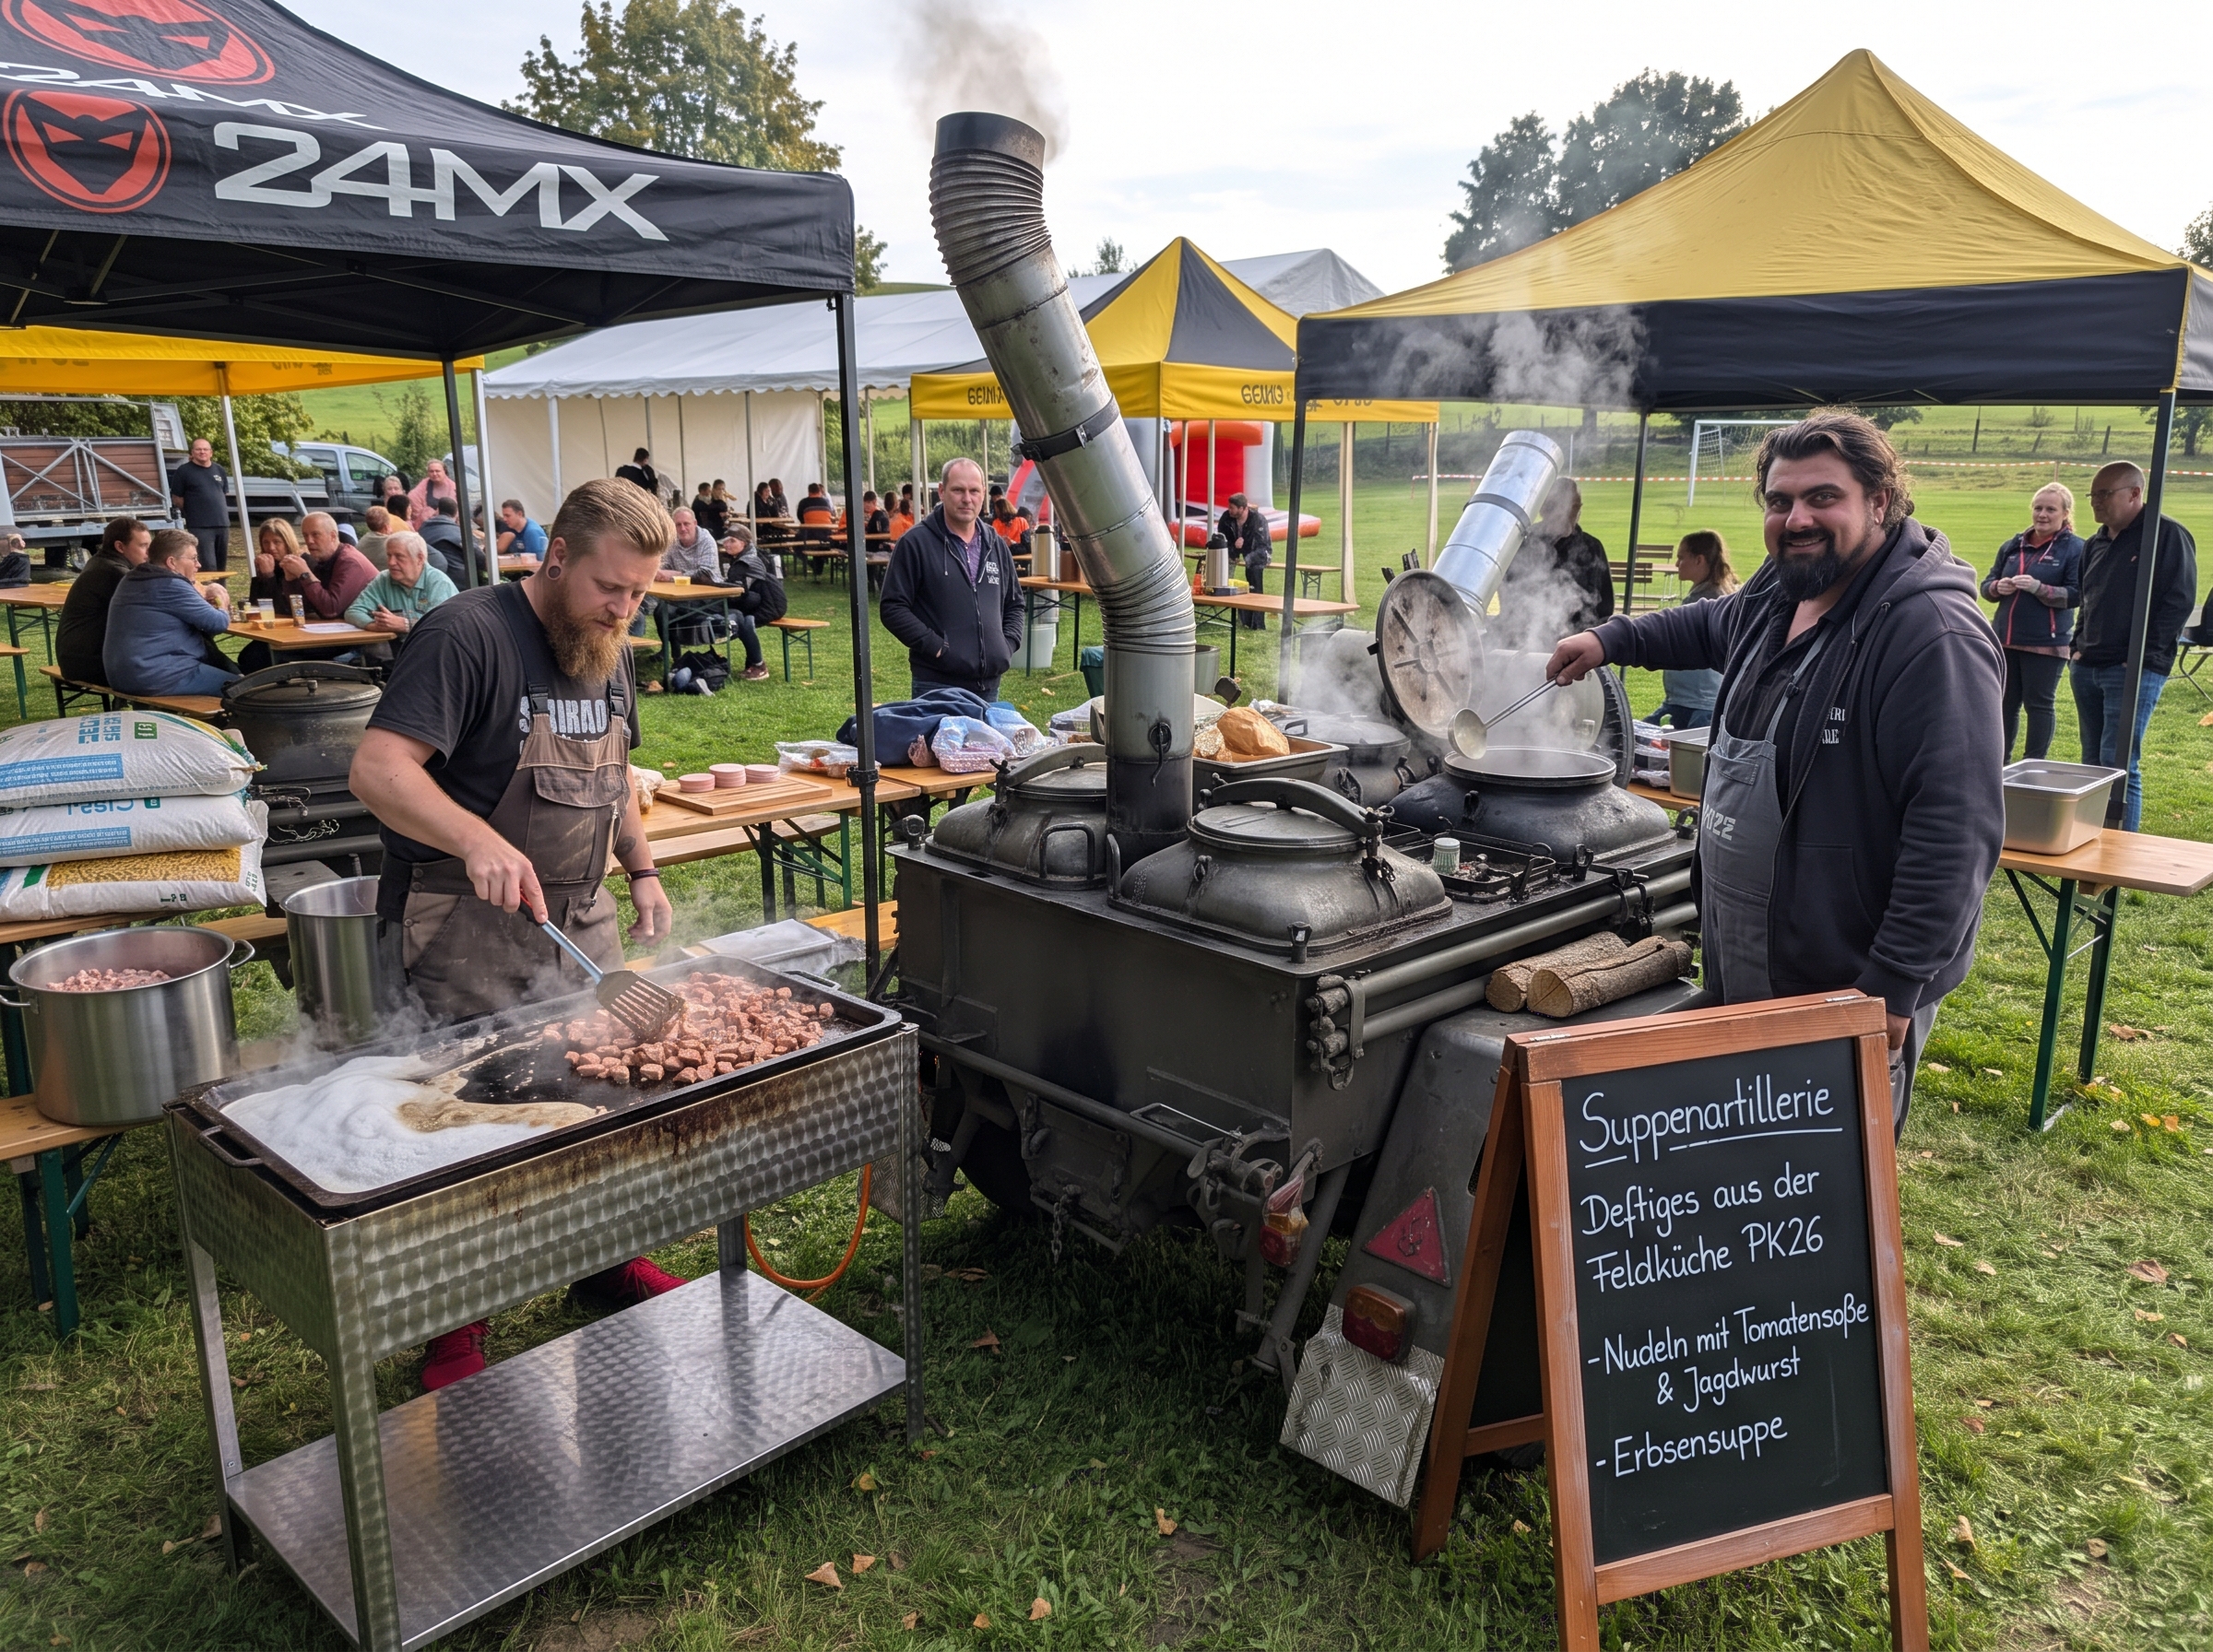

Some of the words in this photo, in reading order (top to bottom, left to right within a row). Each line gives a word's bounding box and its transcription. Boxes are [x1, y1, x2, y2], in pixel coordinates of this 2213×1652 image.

[214, 122, 669, 241] 24MX
[1578, 1073, 1835, 1164] Suppenartillerie
[1580, 1185, 1700, 1239] Deftiges
[1713, 1180, 1763, 1209] aus
[1773, 1161, 1820, 1198] der
[1585, 1234, 1734, 1292] Feldküche
[1740, 1215, 1824, 1263] PK26
[1697, 1316, 1730, 1353] mit
[1733, 1292, 1870, 1345] Tomatensoße
[1656, 1372, 1674, 1406] &
[1683, 1345, 1802, 1413] Jagdwurst
